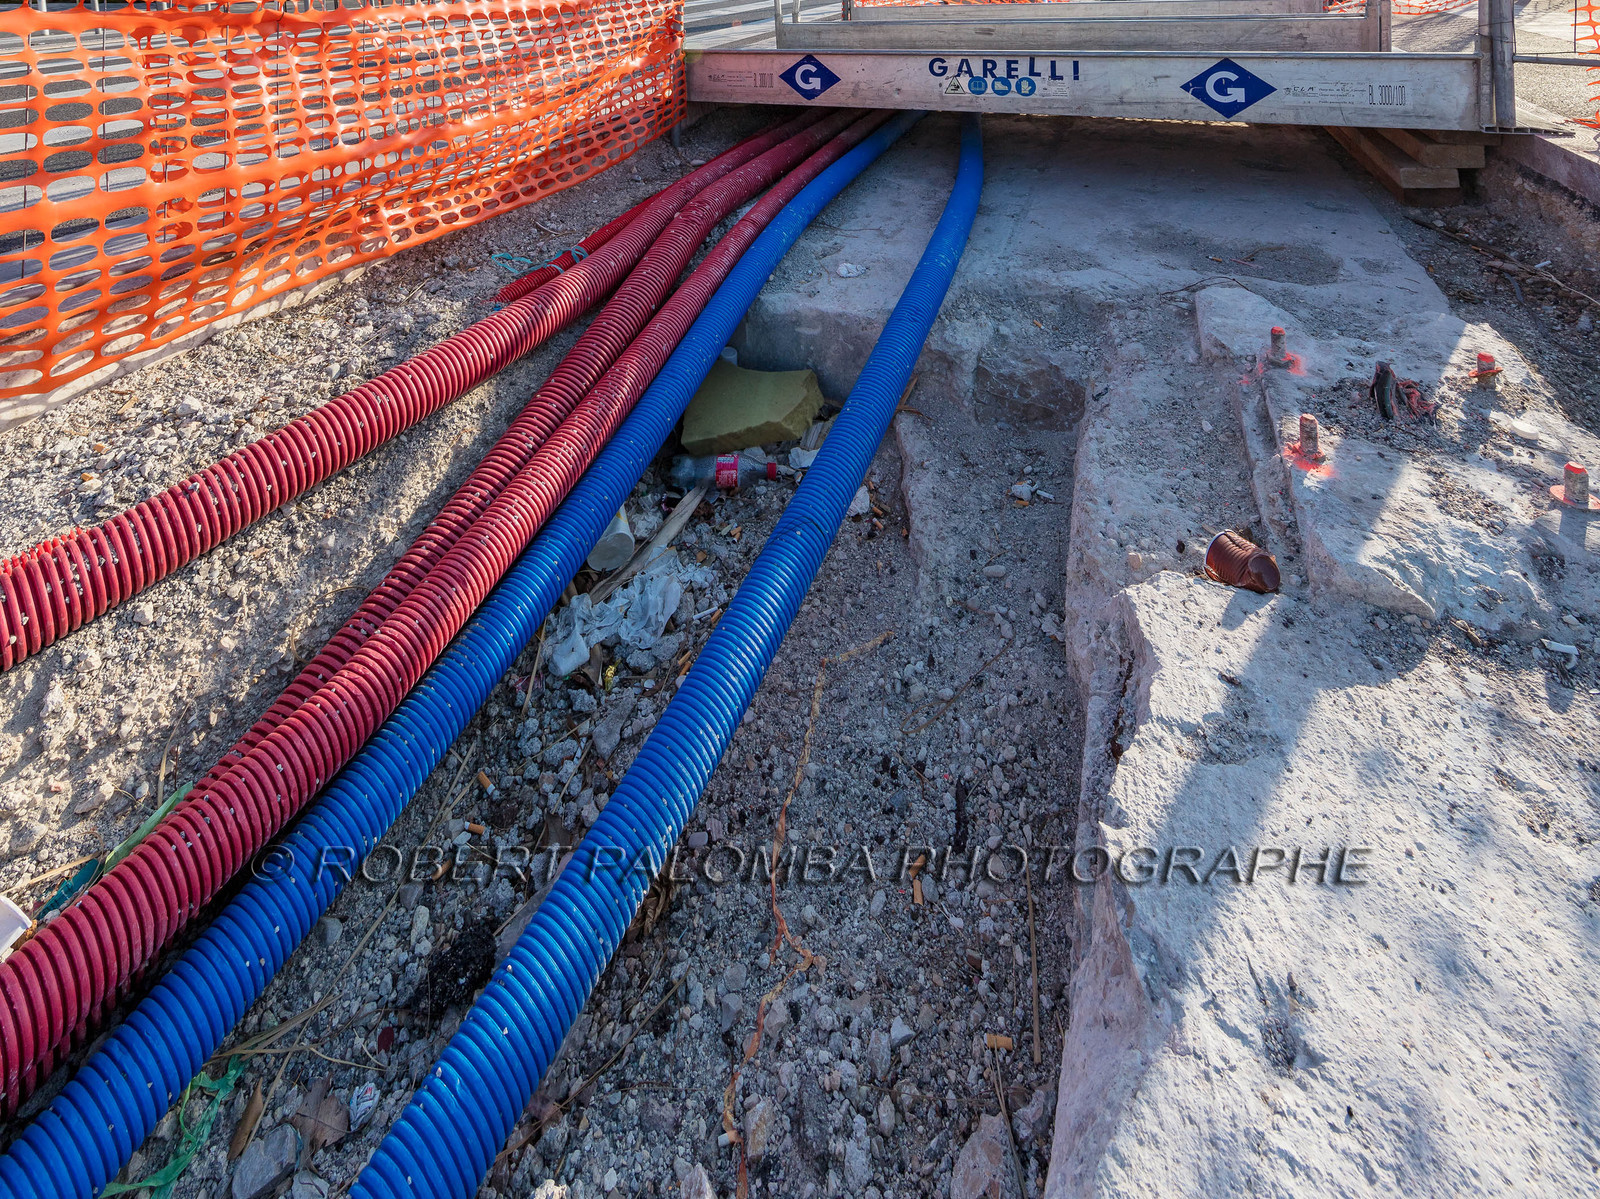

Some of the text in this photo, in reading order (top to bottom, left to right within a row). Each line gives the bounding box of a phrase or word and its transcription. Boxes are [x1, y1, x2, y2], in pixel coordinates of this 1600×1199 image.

[795, 64, 821, 91] G
[928, 56, 1080, 81] GARELLI
[1205, 70, 1246, 103] G
